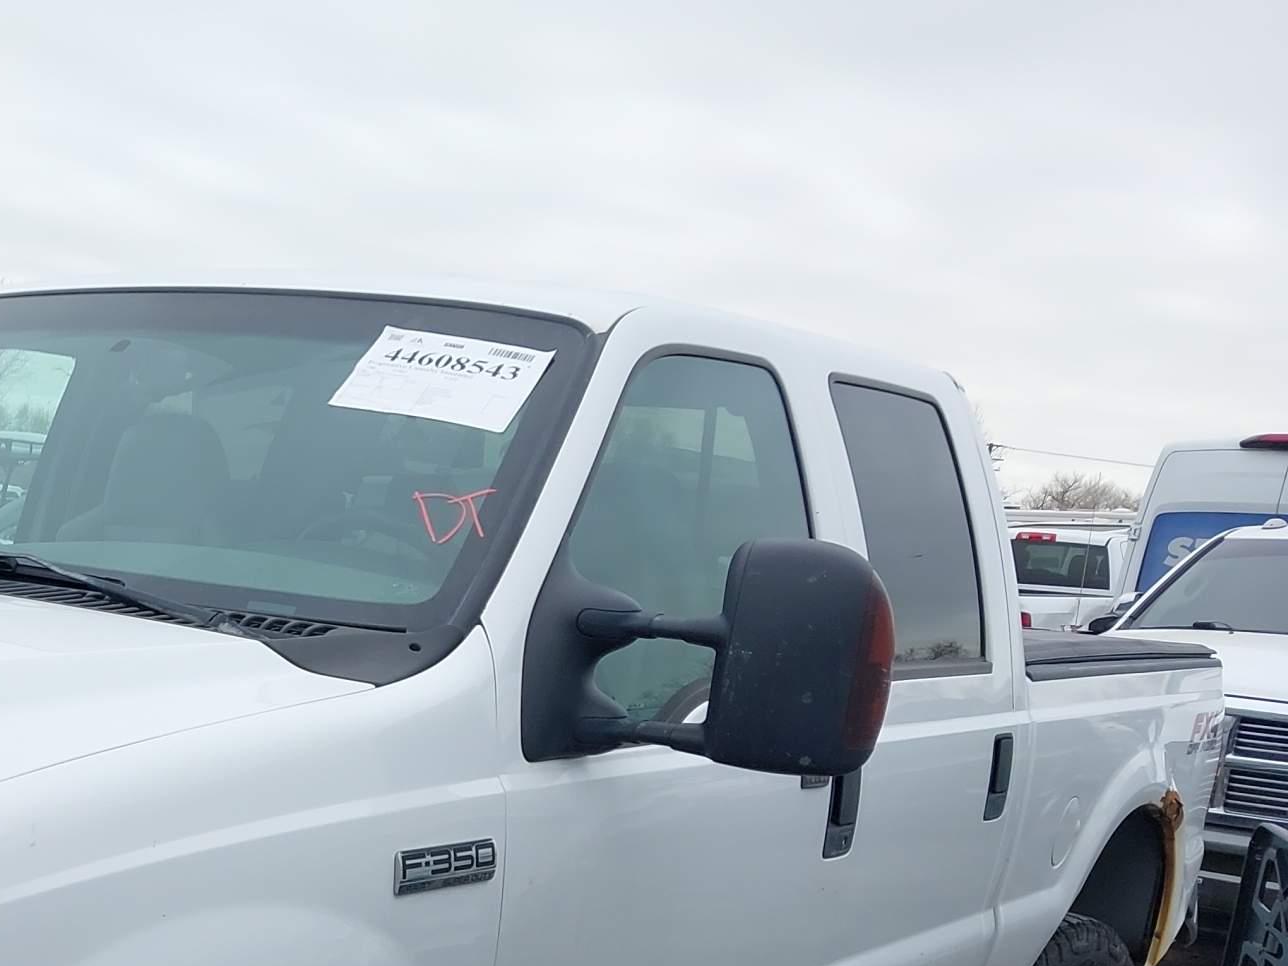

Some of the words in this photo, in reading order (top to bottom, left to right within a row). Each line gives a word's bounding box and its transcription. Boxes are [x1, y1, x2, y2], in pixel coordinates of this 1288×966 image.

[384, 347, 521, 381] 44608543
[412, 488, 497, 544] DT
[401, 842, 496, 881] F-350
